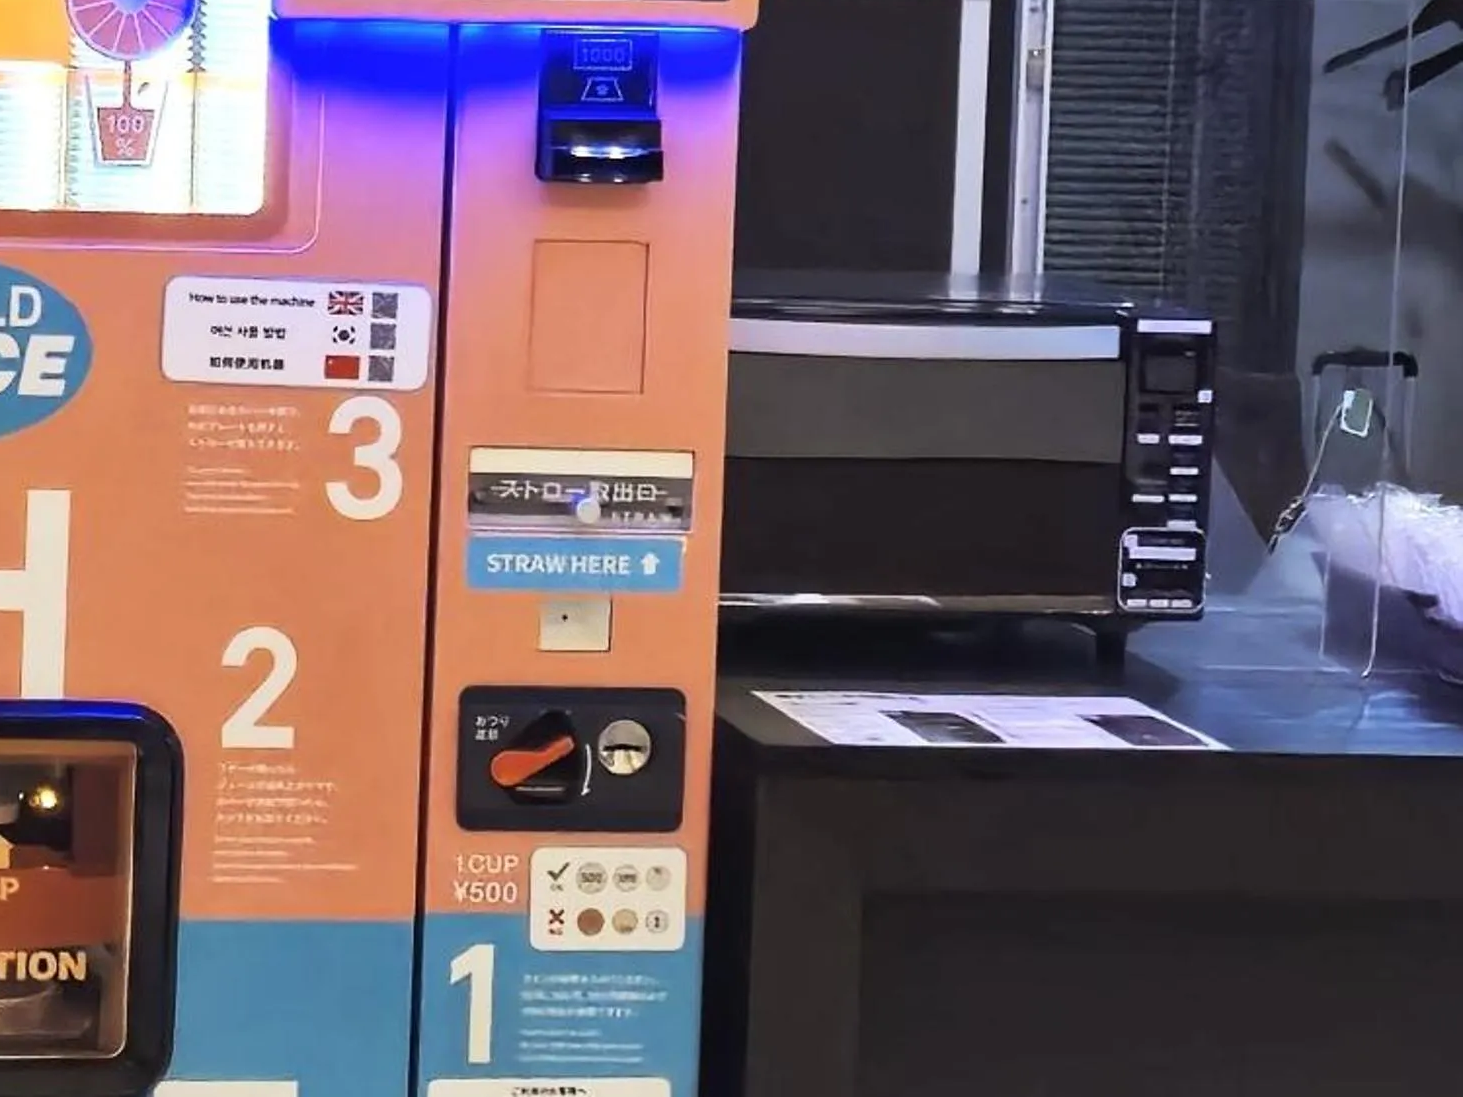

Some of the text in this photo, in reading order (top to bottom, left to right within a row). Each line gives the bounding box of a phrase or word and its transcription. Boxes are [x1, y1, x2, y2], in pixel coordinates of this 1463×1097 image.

[230, 296, 248, 304] use
[250, 294, 268, 305] the
[270, 296, 315, 307] machine
[325, 396, 402, 520] 3
[486, 553, 632, 576] STRAW HERE
[221, 626, 298, 749] 2
[453, 881, 518, 903] ¥500
[450, 943, 495, 1063] 1
